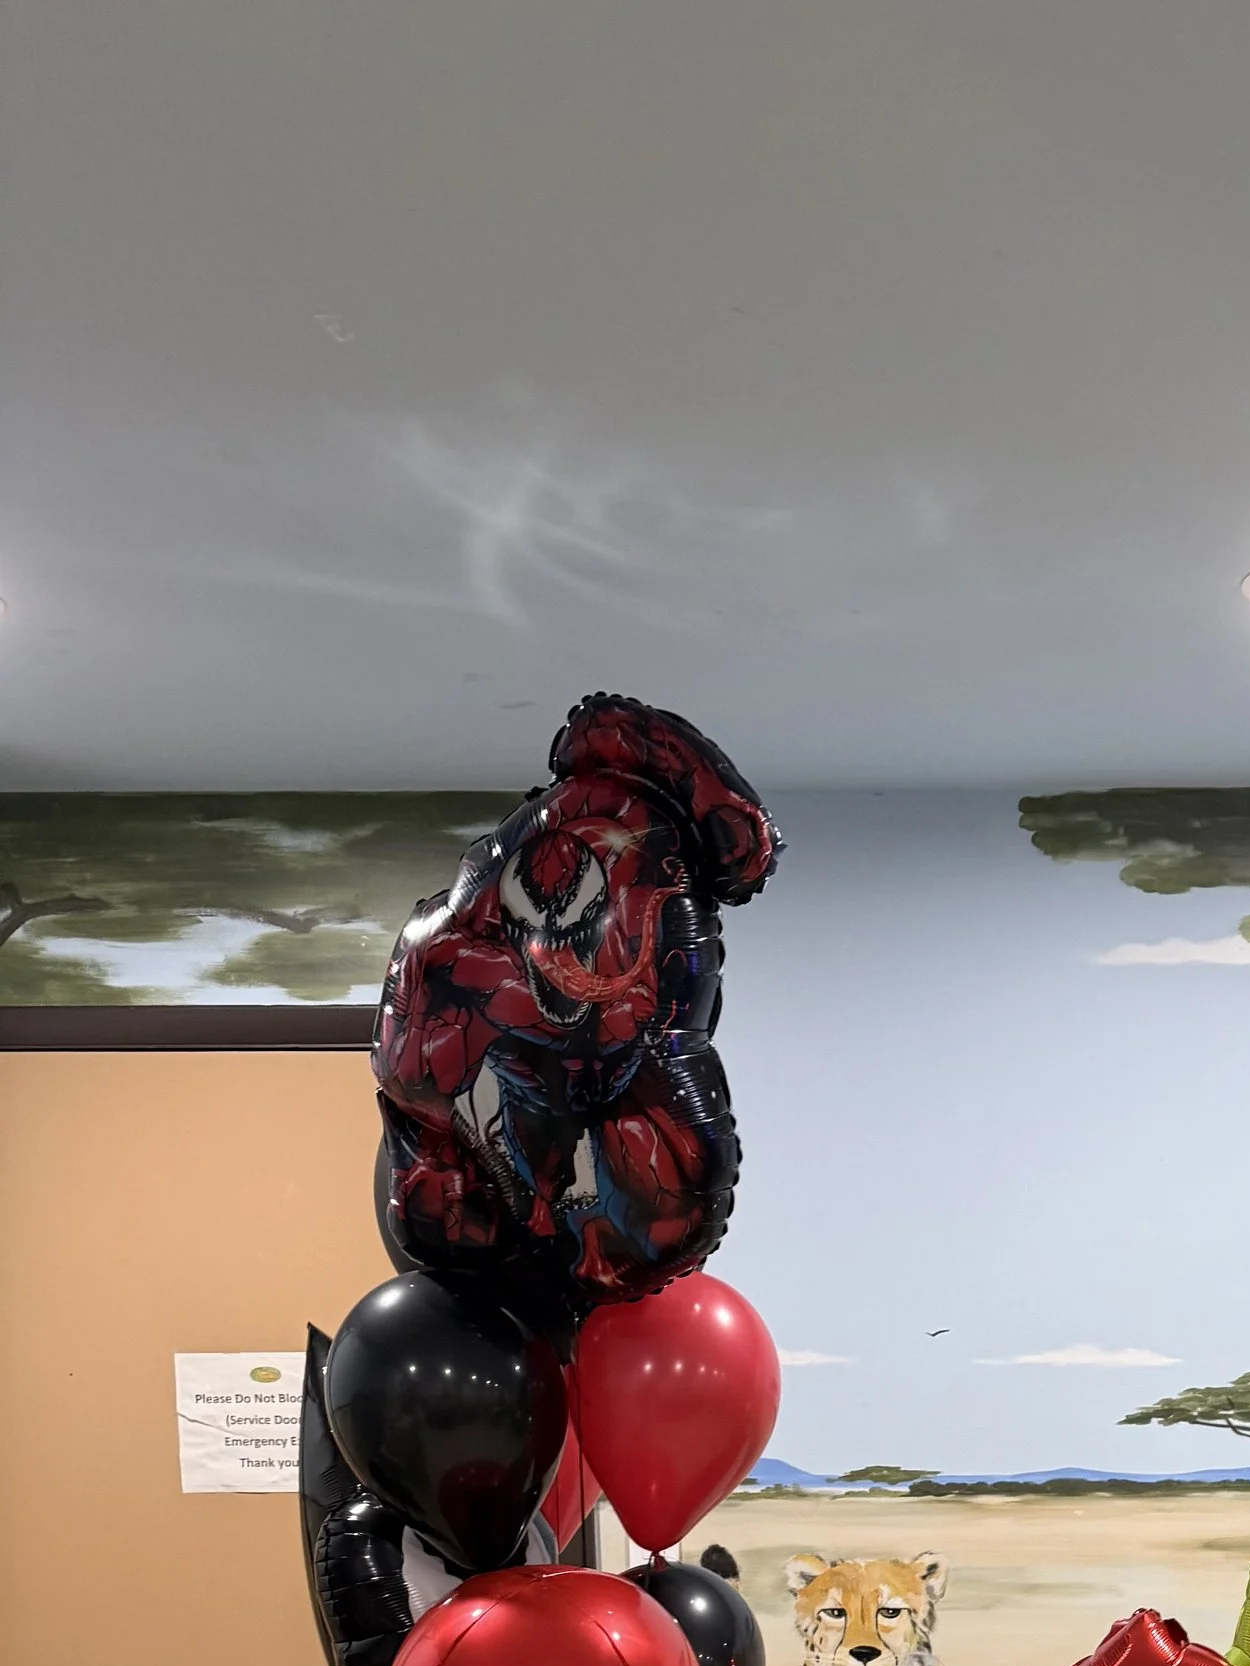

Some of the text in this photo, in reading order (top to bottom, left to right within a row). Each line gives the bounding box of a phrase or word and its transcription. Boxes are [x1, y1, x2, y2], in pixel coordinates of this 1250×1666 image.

[195, 1393, 303, 1404] Please Do Not Bloc
[226, 1414, 271, 1427] (Service
[225, 1437, 287, 1448] Emergency
[240, 1458, 275, 1467] Thank
